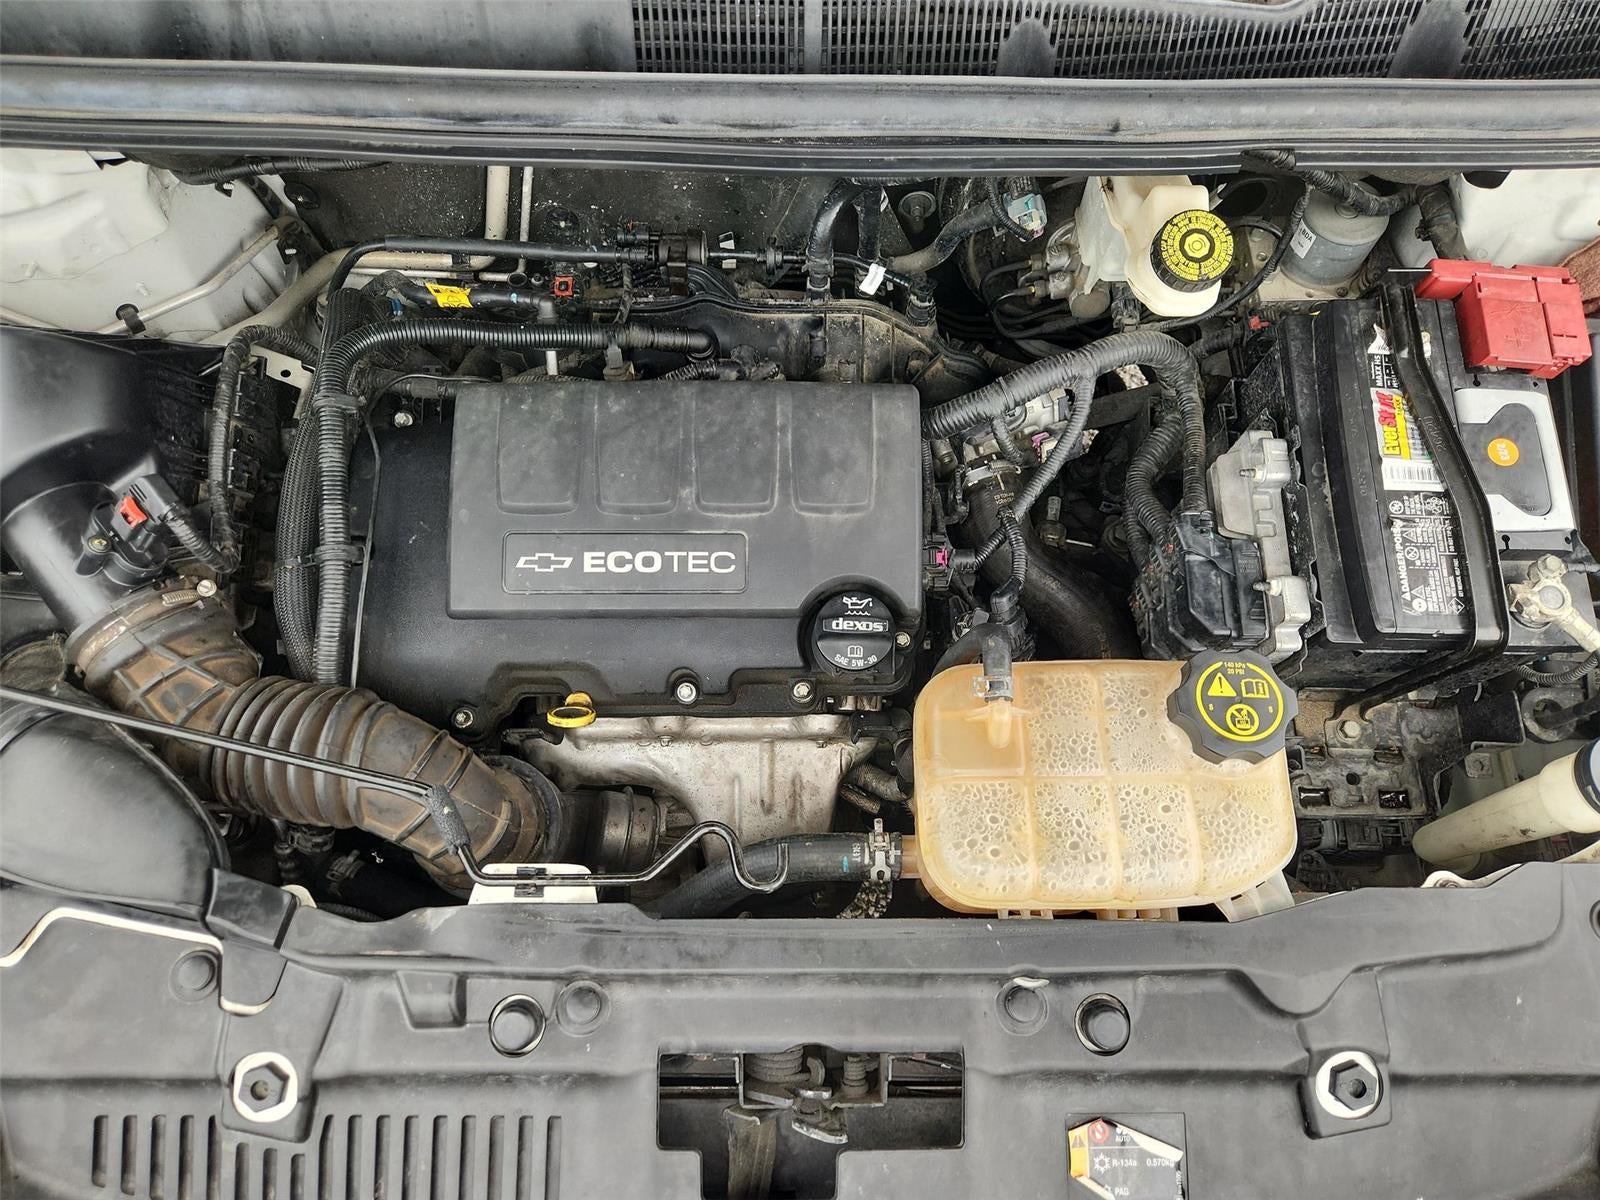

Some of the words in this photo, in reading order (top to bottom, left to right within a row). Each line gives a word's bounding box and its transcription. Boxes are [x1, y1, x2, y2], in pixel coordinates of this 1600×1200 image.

[582, 550, 736, 574] ECOTEC
[832, 618, 884, 632] dexos
[834, 654, 848, 666] SAE
[851, 654, 878, 667] 5W-30
[1112, 1159, 1137, 1167] R-134a
